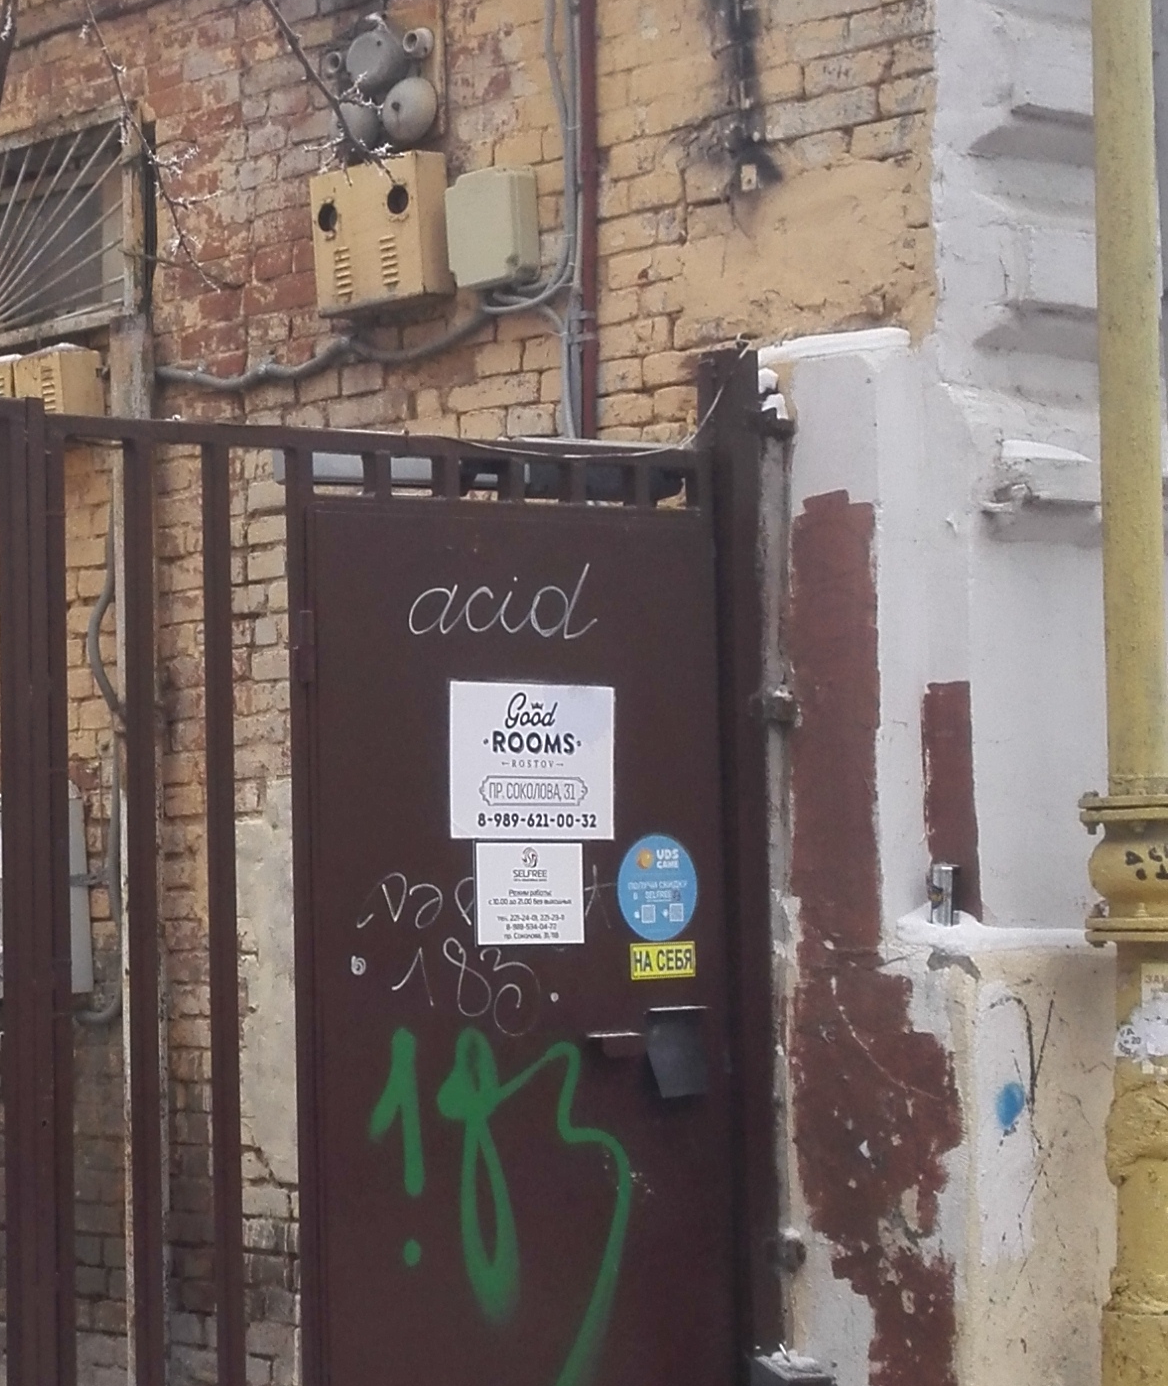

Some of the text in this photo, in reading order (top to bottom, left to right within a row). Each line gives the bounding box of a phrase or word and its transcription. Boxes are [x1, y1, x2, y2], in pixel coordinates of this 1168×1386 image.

[408, 562, 598, 639] acid
[505, 692, 558, 729] Good
[511, 759, 554, 768] ROSTOV
[563, 783, 576, 800] 31
[477, 812, 598, 829] 8-989-621-00-32
[633, 948, 693, 973] НА СЕБЯ
